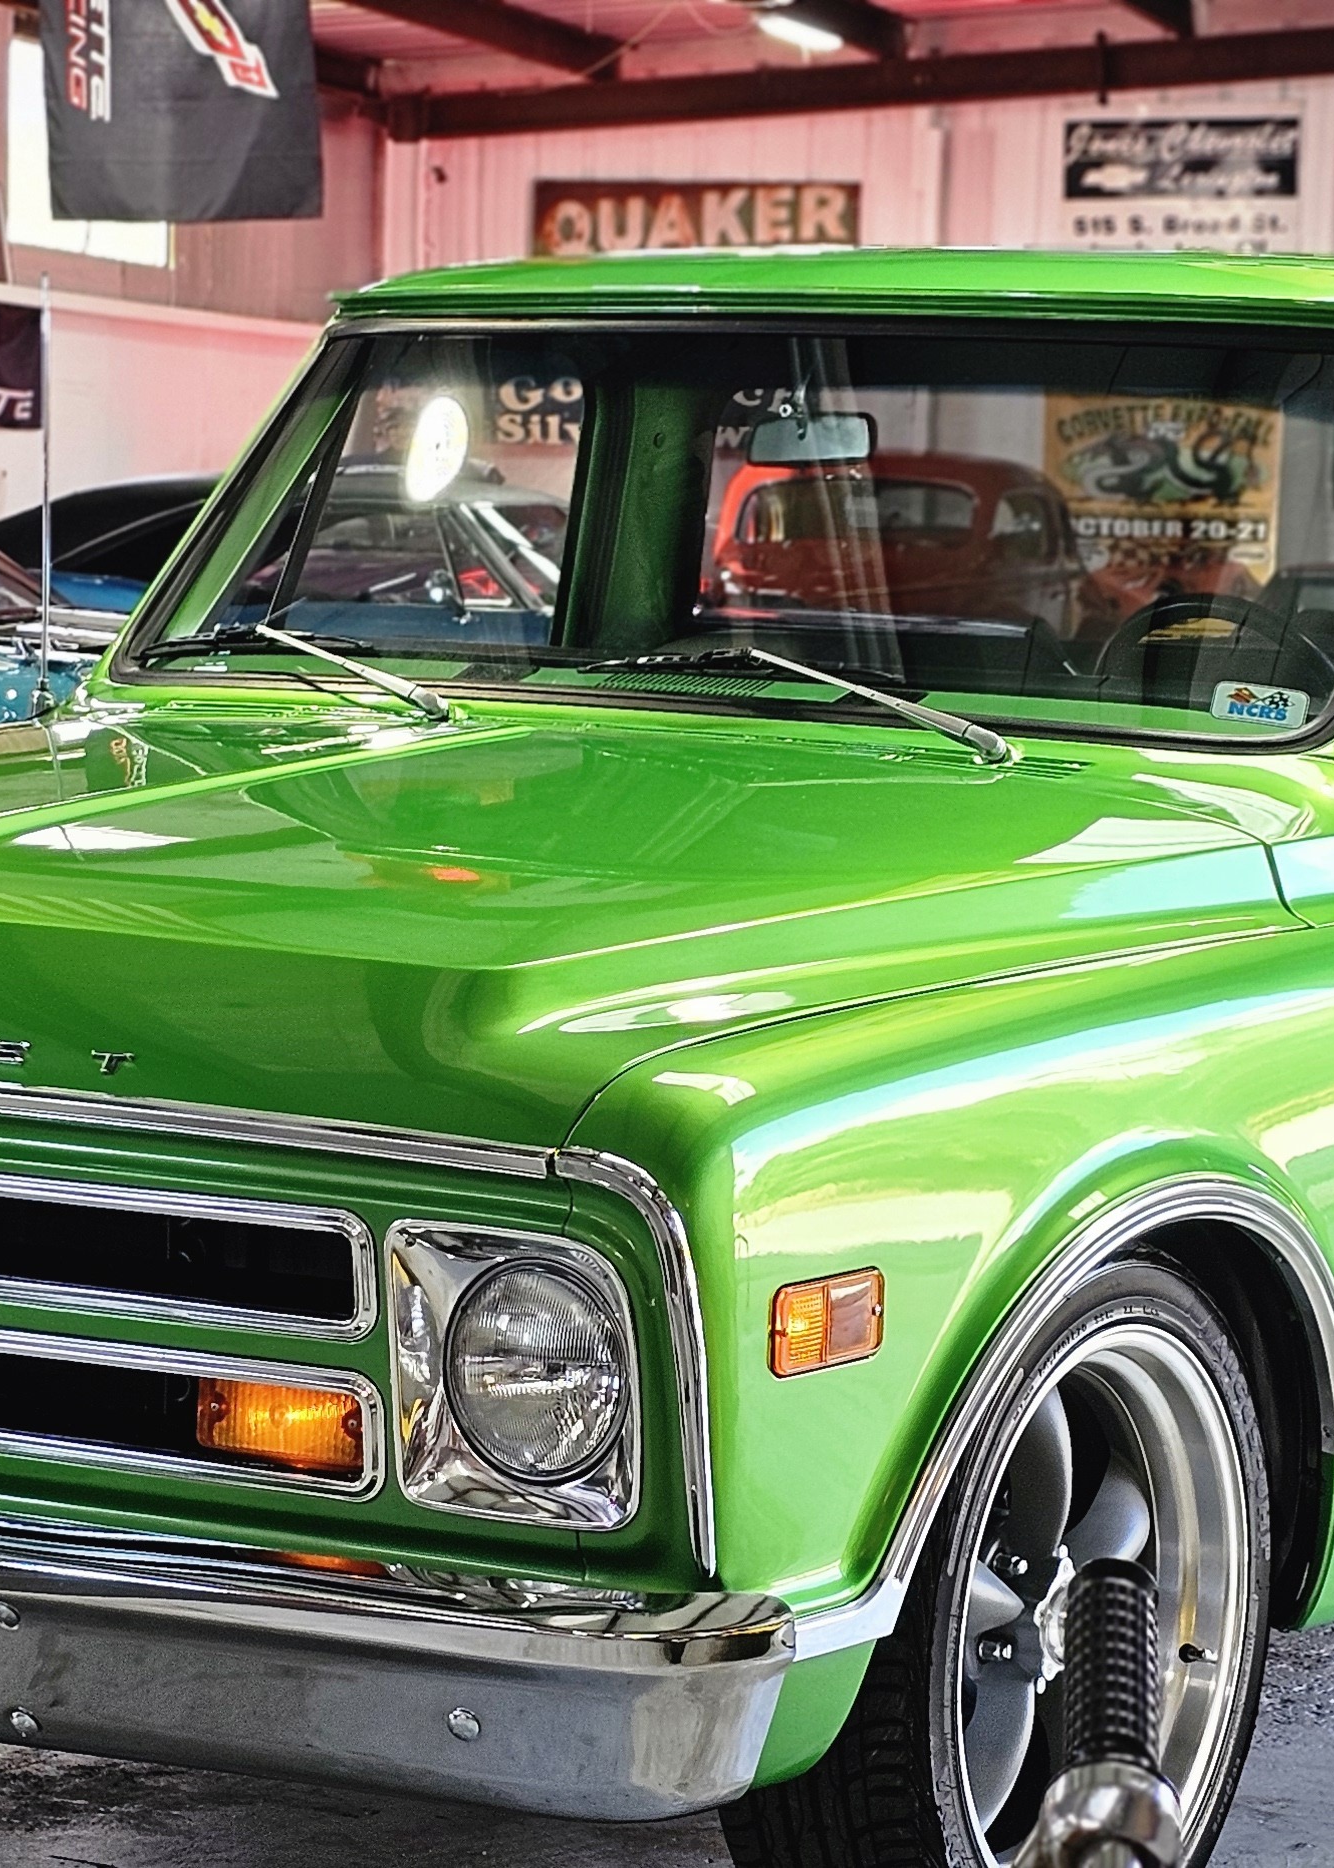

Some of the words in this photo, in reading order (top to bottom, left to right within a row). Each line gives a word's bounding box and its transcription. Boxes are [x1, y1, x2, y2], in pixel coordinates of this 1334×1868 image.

[89, 0, 111, 122] TTE
[543, 185, 848, 256] QUAKER
[1190, 519, 1266, 540] 20-21
[1227, 702, 1288, 721] NCRS
